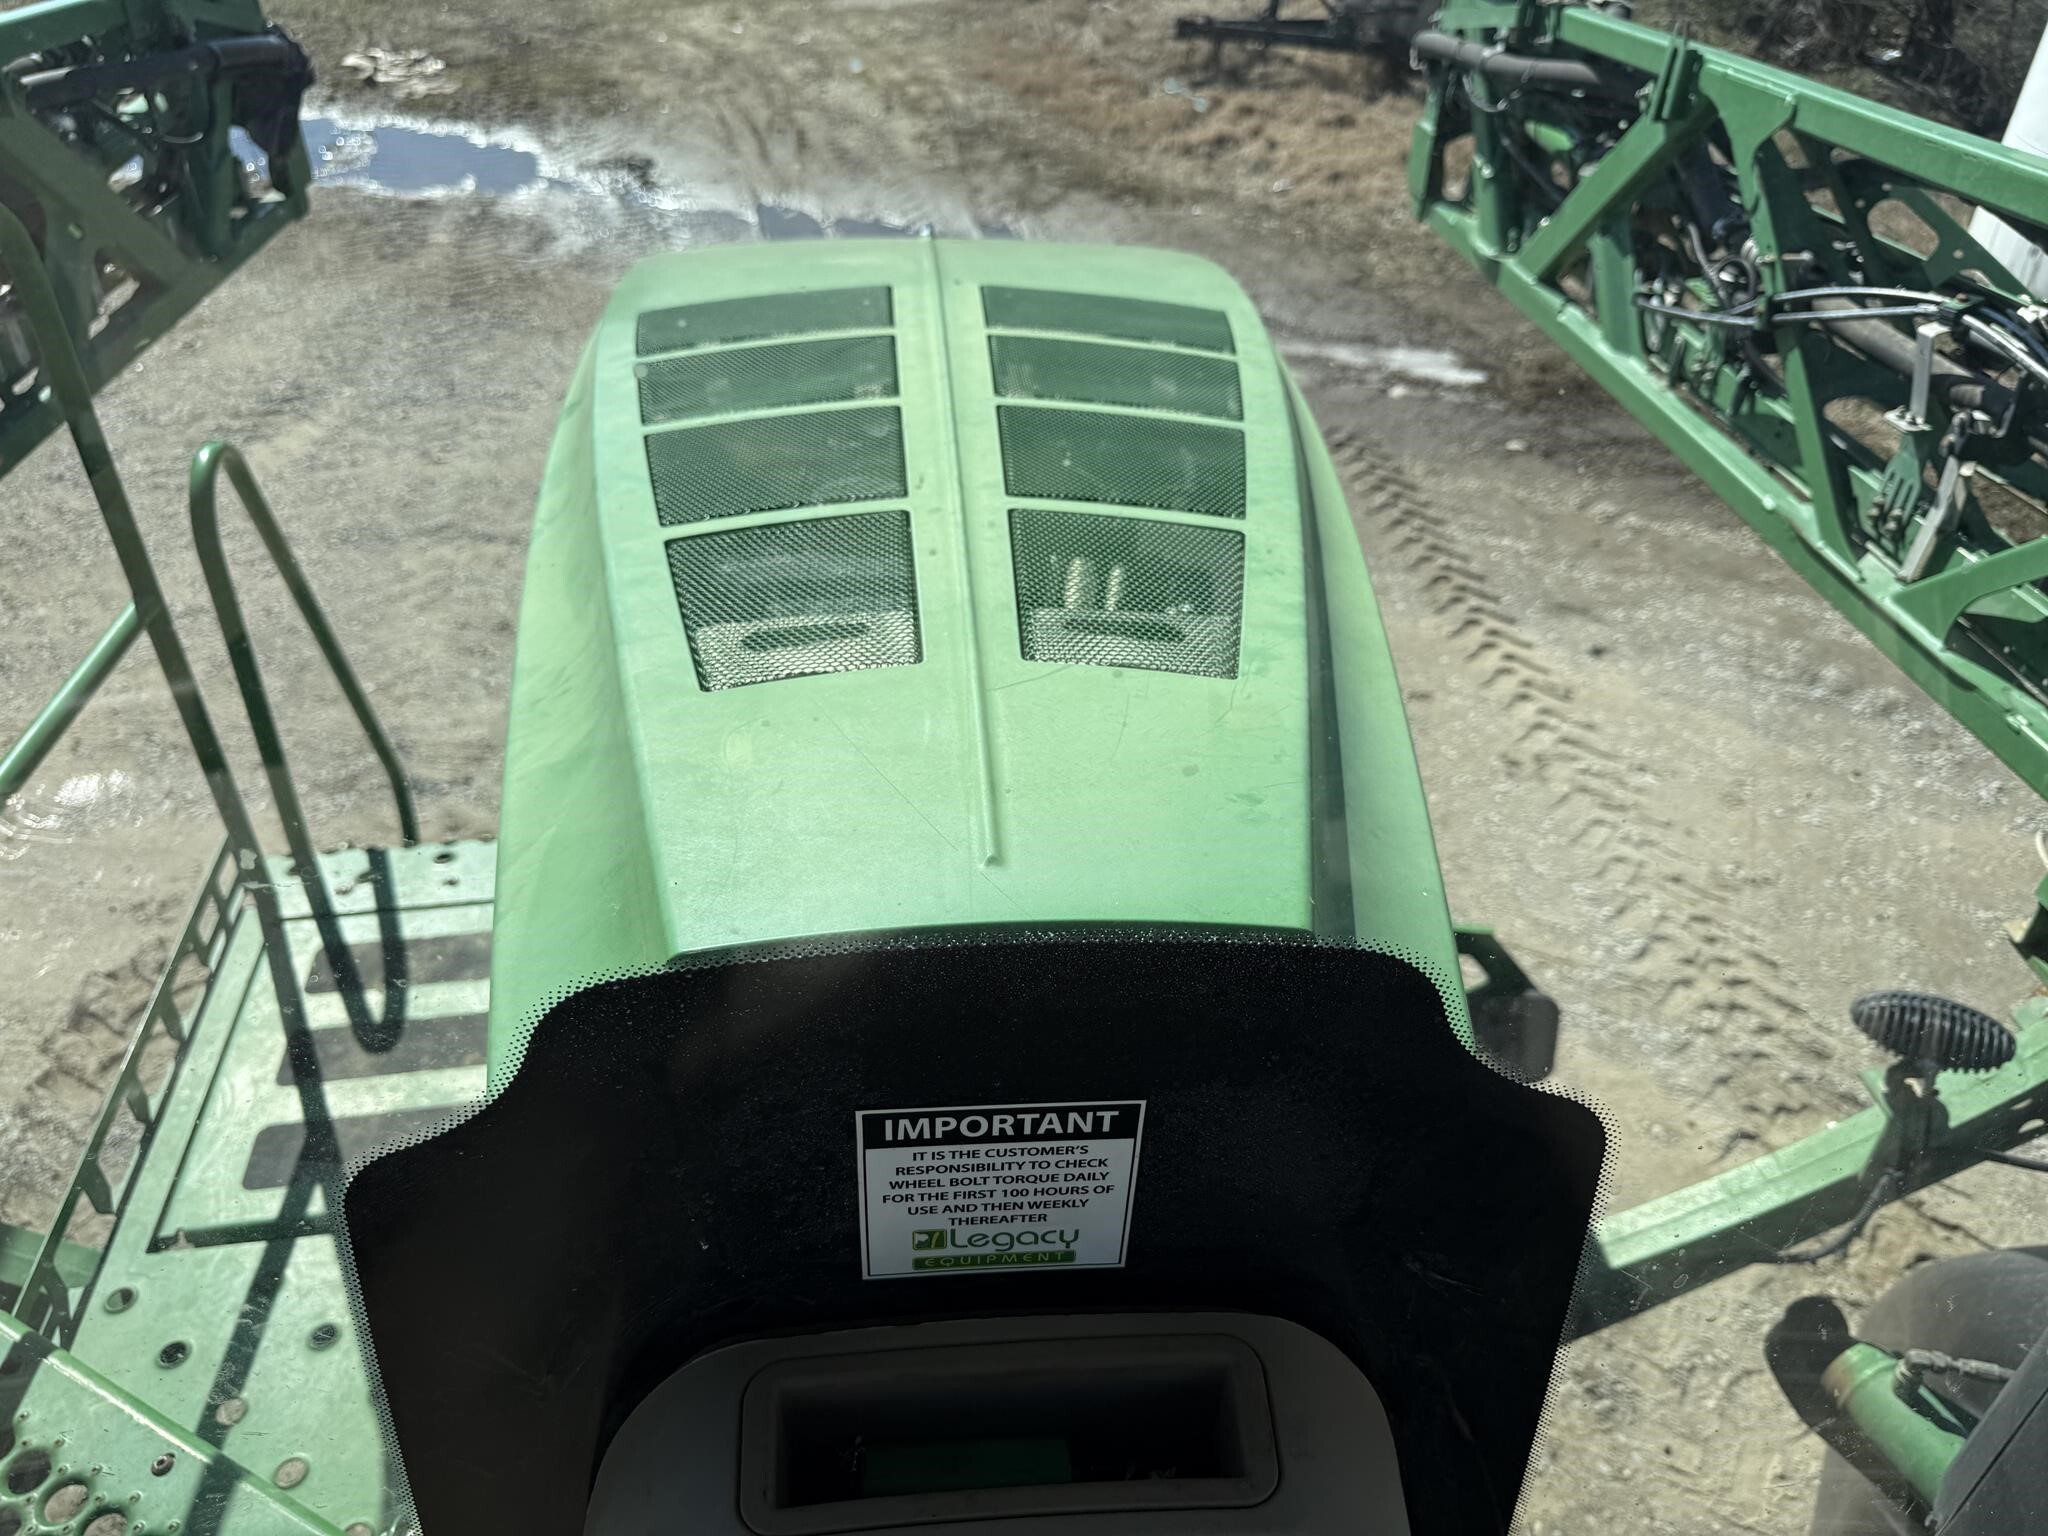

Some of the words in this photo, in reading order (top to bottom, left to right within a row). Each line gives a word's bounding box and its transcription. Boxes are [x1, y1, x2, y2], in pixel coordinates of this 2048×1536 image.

[885, 1110, 1119, 1141] IMPORTANT
[913, 1152, 927, 1161] IT
[932, 1151, 945, 1160] IS
[949, 1149, 980, 1160] THE
[985, 1146, 1088, 1158] CUSTOMER'S
[896, 1162, 1026, 1176] RESPONSIBILITY
[1029, 1160, 1050, 1170] TO
[1055, 1158, 1108, 1168] CHECK
[889, 1179, 945, 1190] WHEEL
[950, 1177, 992, 1186] BOLT
[993, 1174, 1059, 1185] TORQUE
[1064, 1172, 1109, 1182] DAILY
[883, 1193, 915, 1203] FOR
[918, 1192, 950, 1202] THE
[954, 1190, 997, 1200] FIRST
[1002, 1189, 1029, 1198] 100
[1034, 1186, 1090, 1196] HOURS
[1094, 1185, 1115, 1194] OF
[908, 1205, 938, 1215] USE
[942, 1204, 978, 1213] AND
[982, 1202, 1024, 1212] THEN
[1028, 1199, 1089, 1210] WEEKLY
[948, 1214, 1047, 1226] THEREAFTER
[950, 1229, 1080, 1252] Legacy
[925, 1252, 1064, 1266] EQUIPMENT
